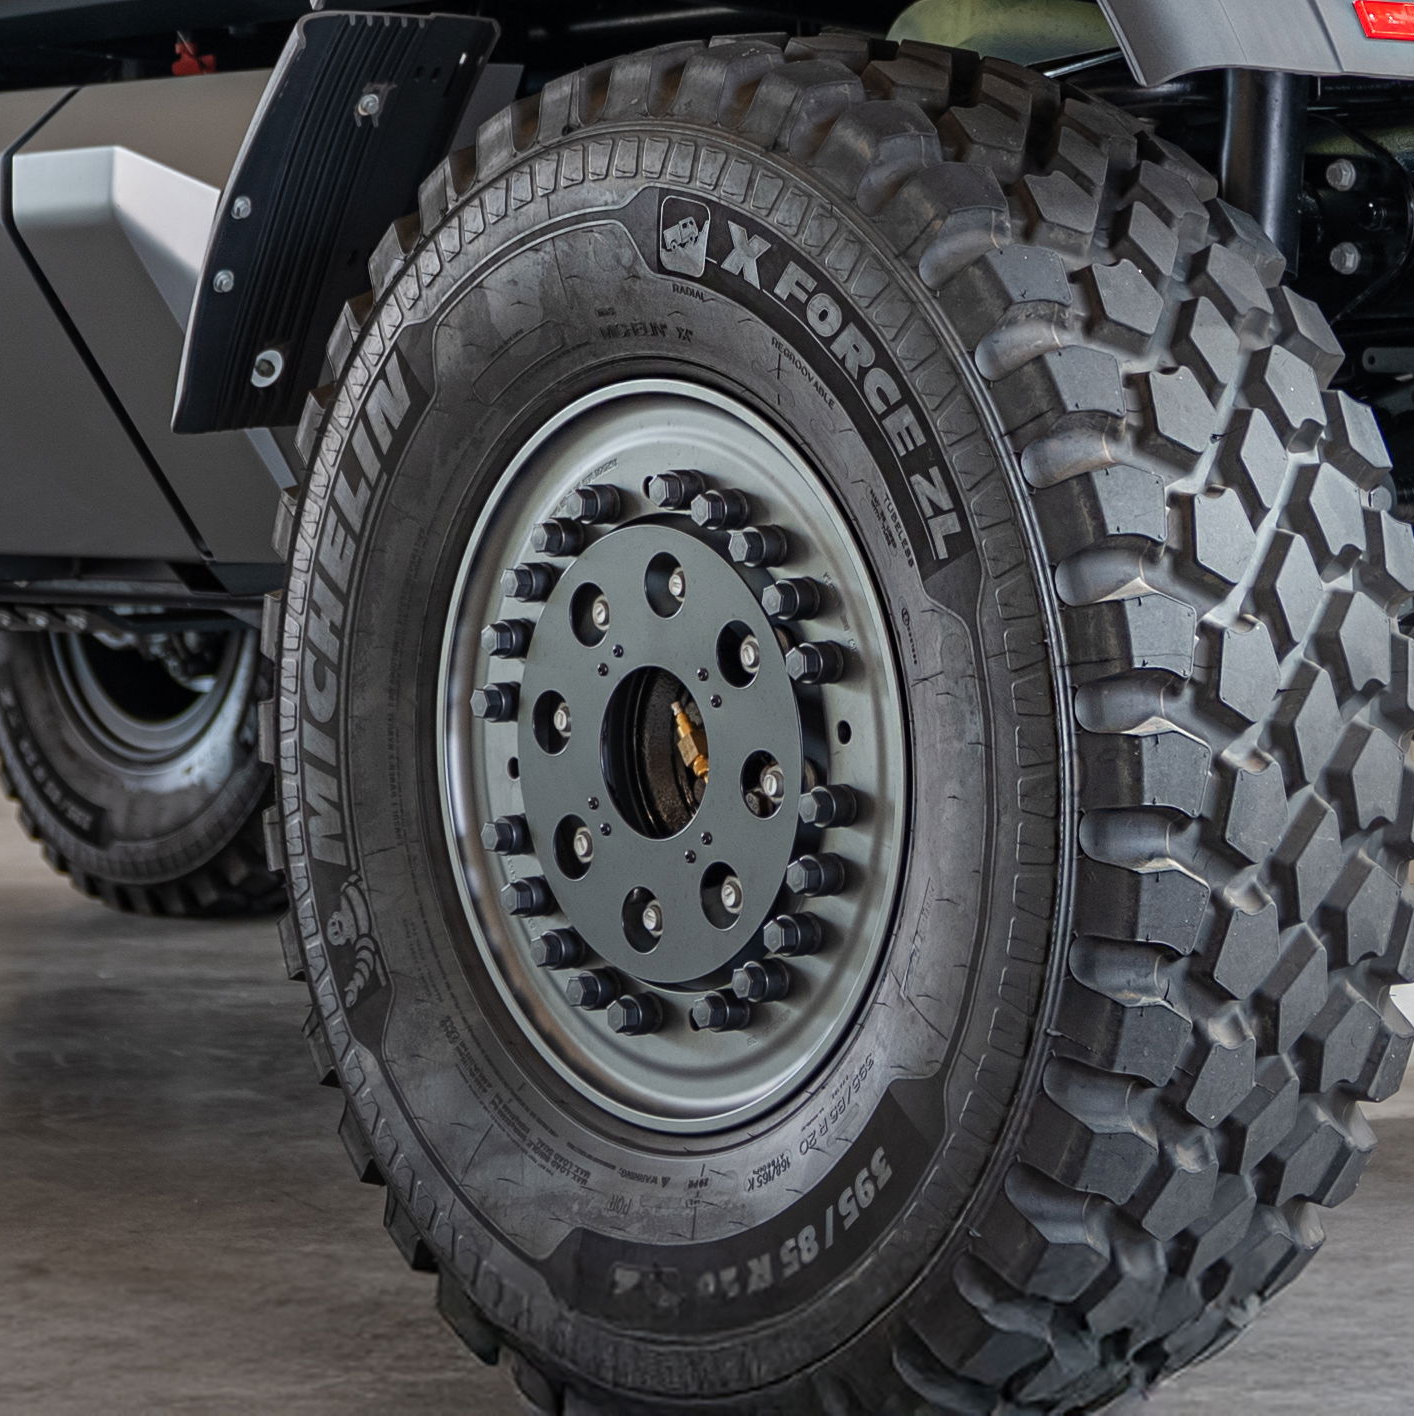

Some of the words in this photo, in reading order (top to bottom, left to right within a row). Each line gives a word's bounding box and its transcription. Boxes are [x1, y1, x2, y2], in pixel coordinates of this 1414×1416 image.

[672, 283, 705, 300] RADIAL
[720, 220, 771, 290] X
[774, 261, 926, 457] FORCE
[909, 465, 962, 560] ZL
[767, 335, 840, 411] REGROOVABLE
[883, 493, 915, 568] TUBELESS
[302, 349, 412, 866] MICHELIN
